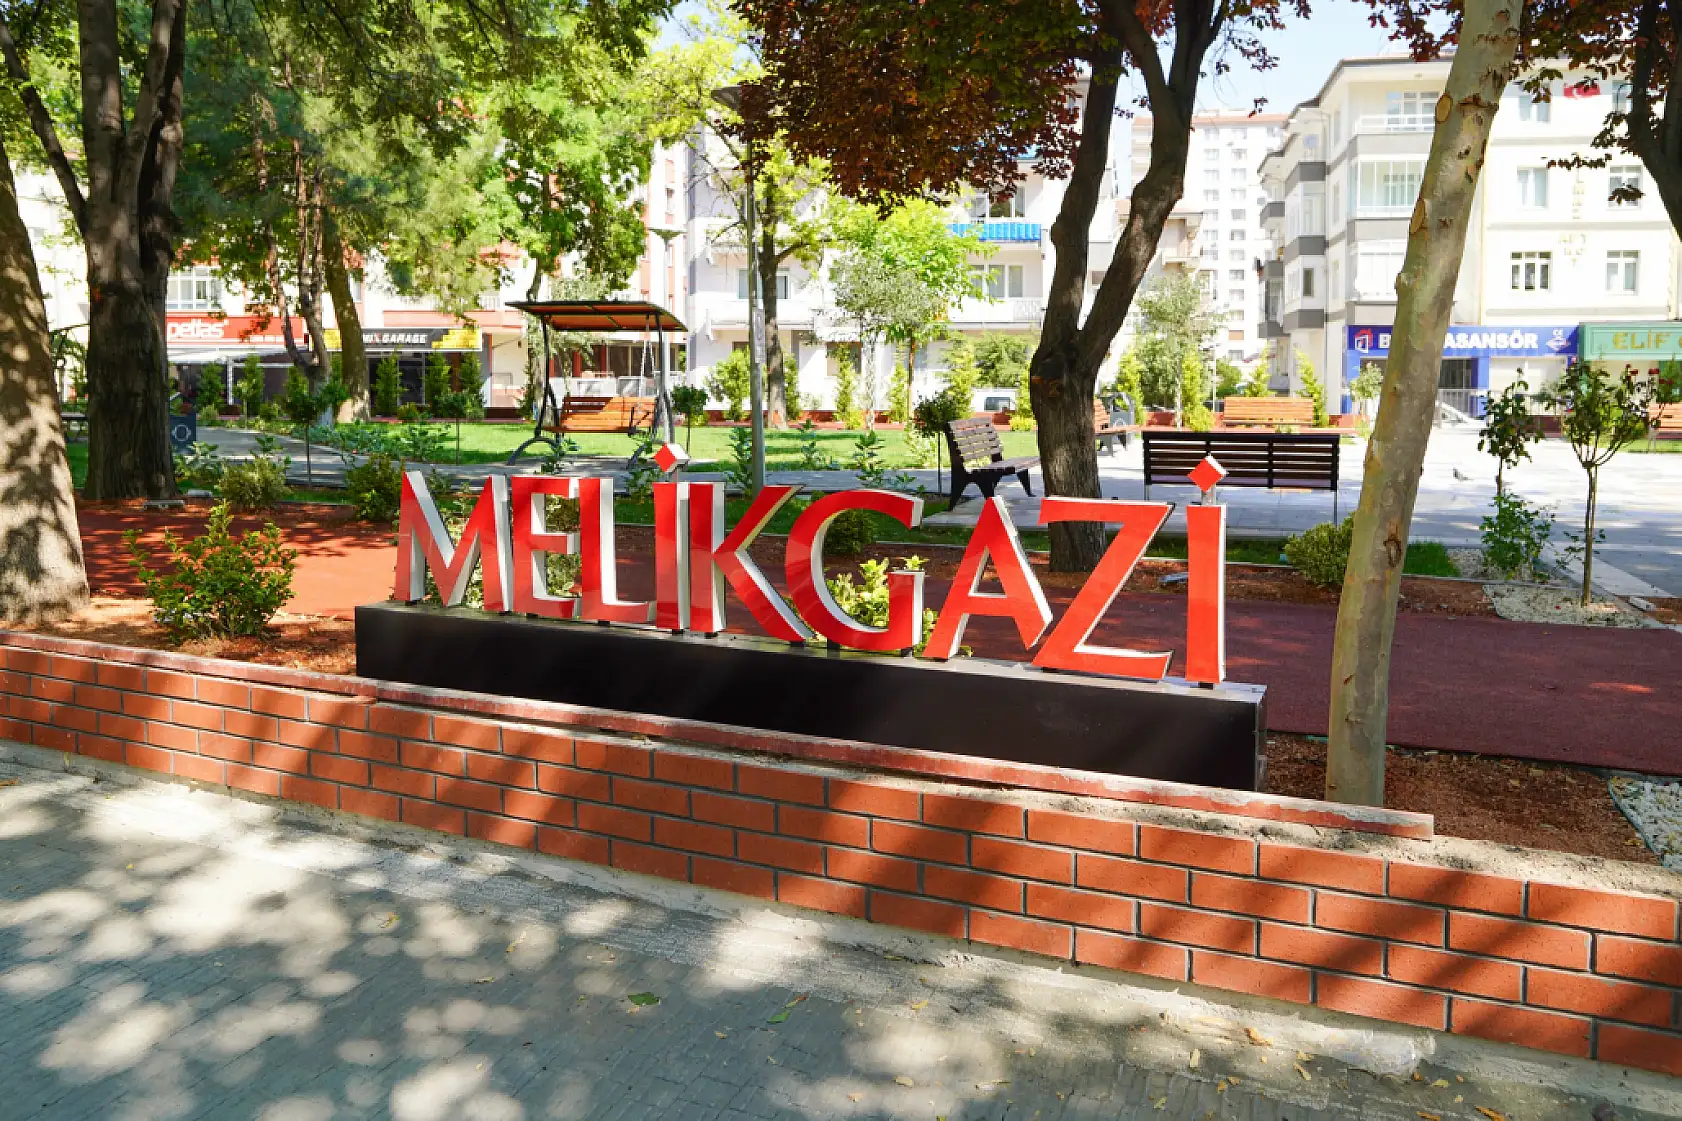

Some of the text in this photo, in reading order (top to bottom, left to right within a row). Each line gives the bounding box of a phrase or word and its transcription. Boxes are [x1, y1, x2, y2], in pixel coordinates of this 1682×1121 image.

[383, 332, 428, 344] GARAGE
[1443, 329, 1538, 349] ASANSÖR
[394, 442, 1227, 684] MELİKGAZİ
